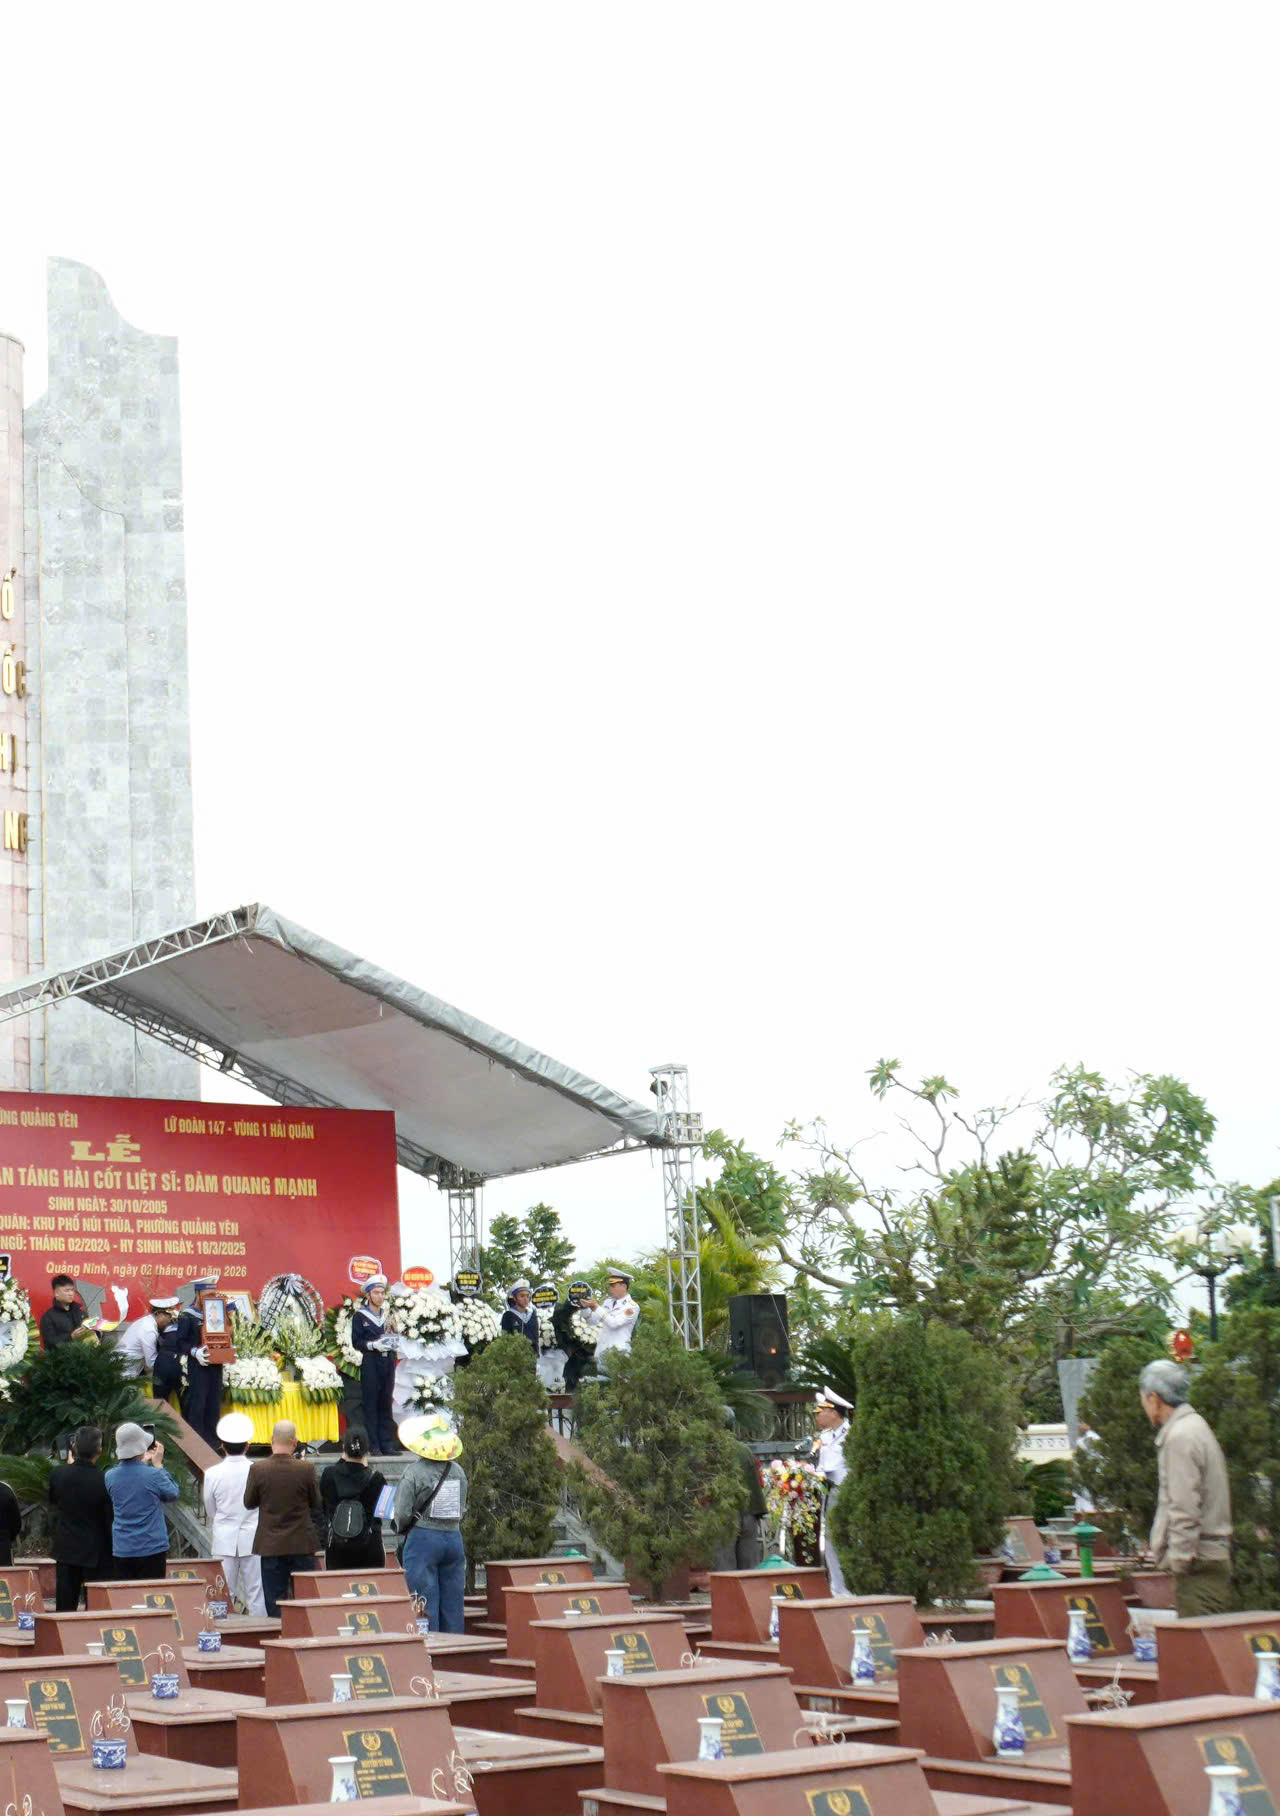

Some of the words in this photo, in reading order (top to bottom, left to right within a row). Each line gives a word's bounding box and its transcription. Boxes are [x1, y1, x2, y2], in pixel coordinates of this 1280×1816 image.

[21, 1107, 56, 1128] QUẢNG
[58, 1110, 78, 1128] YÊN
[164, 1115, 178, 1133] LỮ
[179, 1117, 206, 1135] ĐOÀN
[208, 1120, 225, 1135] 147
[234, 1120, 260, 1137] VÙNG
[262, 1123, 268, 1138] 1
[270, 1119, 287, 1138] HẢI
[289, 1122, 315, 1140] QUÂN
[70, 1133, 142, 1163] LỄ
[18, 1165, 59, 1188] TÁNG
[63, 1166, 89, 1188] HÀI
[94, 1165, 122, 1190] CỐT
[127, 1169, 157, 1195] LIỆT
[161, 1170, 181, 1192] SĨ:
[185, 1171, 219, 1193] ĐÀM
[223, 1175, 271, 1196] QUANG
[274, 1178, 317, 1200] MẠNH
[48, 1196, 74, 1212] SINH
[77, 1195, 108, 1212] NGÀY:
[110, 1199, 168, 1214] 30/10/2005
[33, 1216, 56, 1231] KHU
[58, 1213, 80, 1231] PHỐ
[82, 1216, 102, 1232] NÚI
[136, 1217, 179, 1234] PHƯỜNG
[181, 1217, 217, 1236] QUẢNG
[219, 1219, 239, 1236] YÊN
[0, 1233, 27, 1250] NGŨ:
[29, 1235, 66, 1252] THÁNG
[68, 1238, 110, 1252] 02/2024
[120, 1239, 134, 1253] HY
[136, 1239, 162, 1254] SINH
[164, 1238, 195, 1255] NGÀY:
[196, 1241, 246, 1256] 18/3/2025
[46, 1260, 80, 1277] Quảng
[83, 1262, 110, 1276] Ninh,
[113, 1264, 137, 1277] ngày
[140, 1264, 152, 1275] 02
[155, 1264, 183, 1278] tháng
[186, 1265, 198, 1276] 01
[200, 1265, 222, 1277] năm
[223, 1266, 247, 1277] 2026
